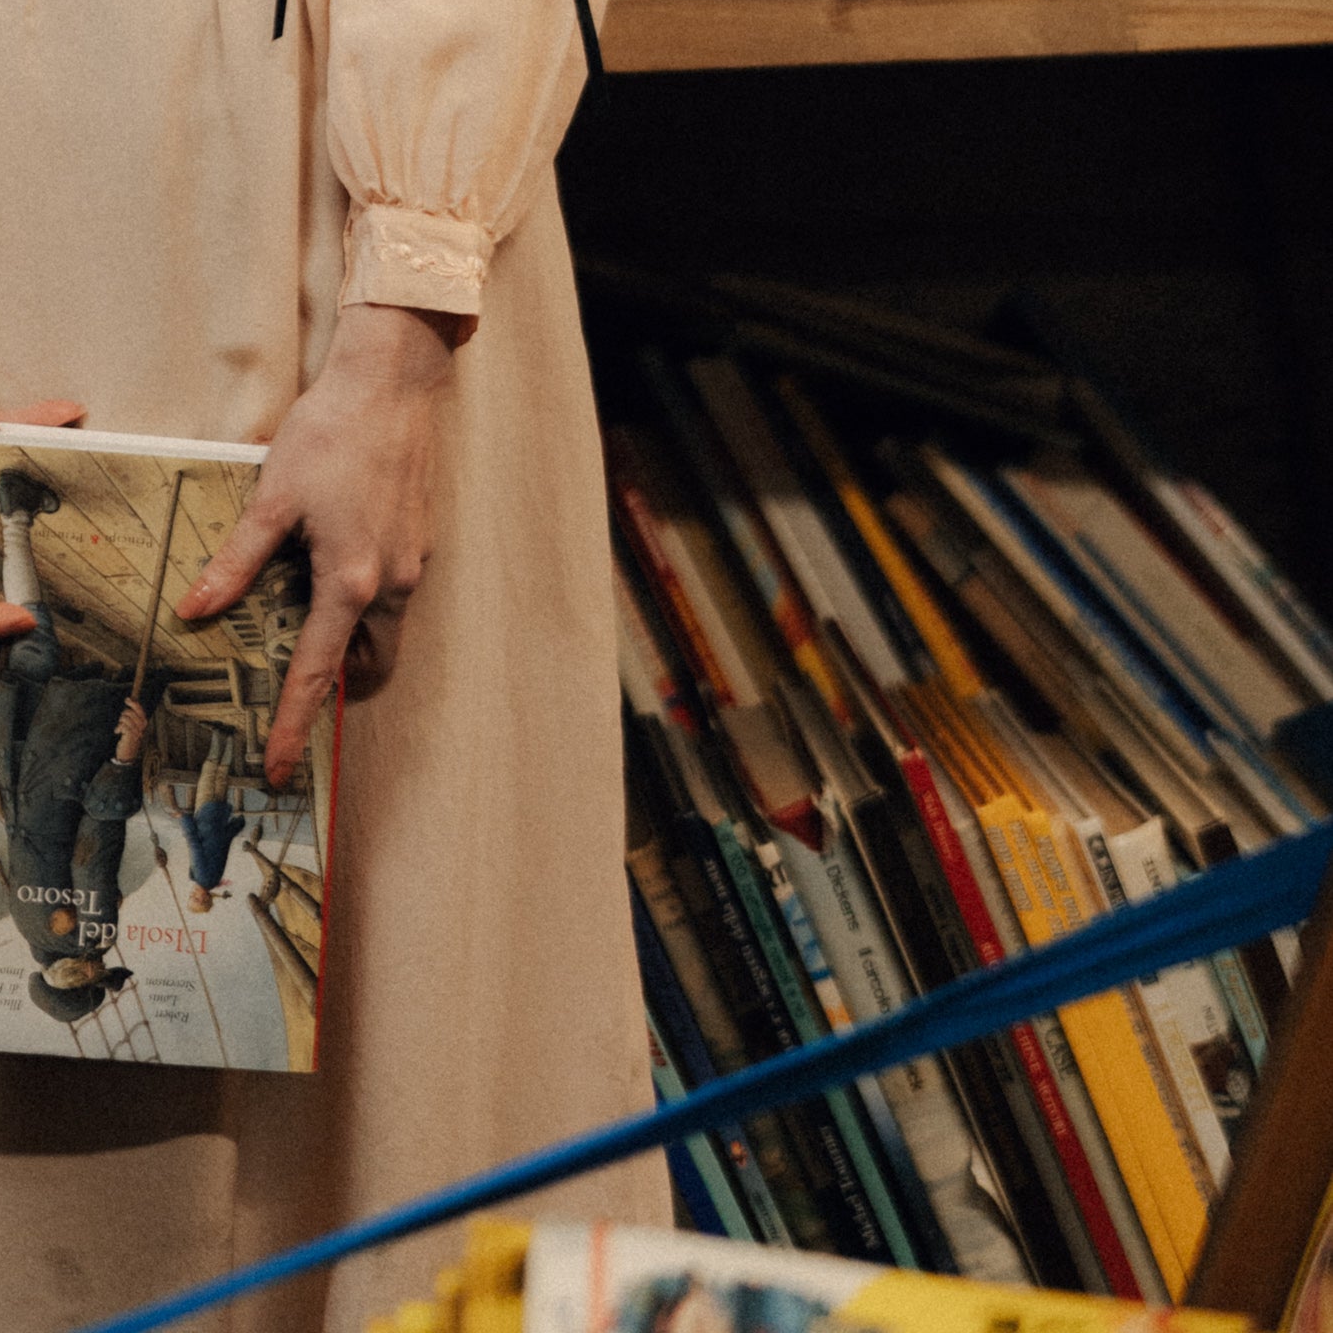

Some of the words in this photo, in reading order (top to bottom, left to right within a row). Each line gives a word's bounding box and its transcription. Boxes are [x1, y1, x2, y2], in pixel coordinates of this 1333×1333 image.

[89, 534, 99, 545] &
[15, 882, 104, 915] Tesoro
[822, 863, 864, 932] Dickens
[76, 920, 116, 949] del
[122, 919, 210, 960] L'Isola
[144, 976, 196, 991] Stevenson
[147, 992, 177, 1006] Louis
[154, 1008, 189, 1023] Robert
